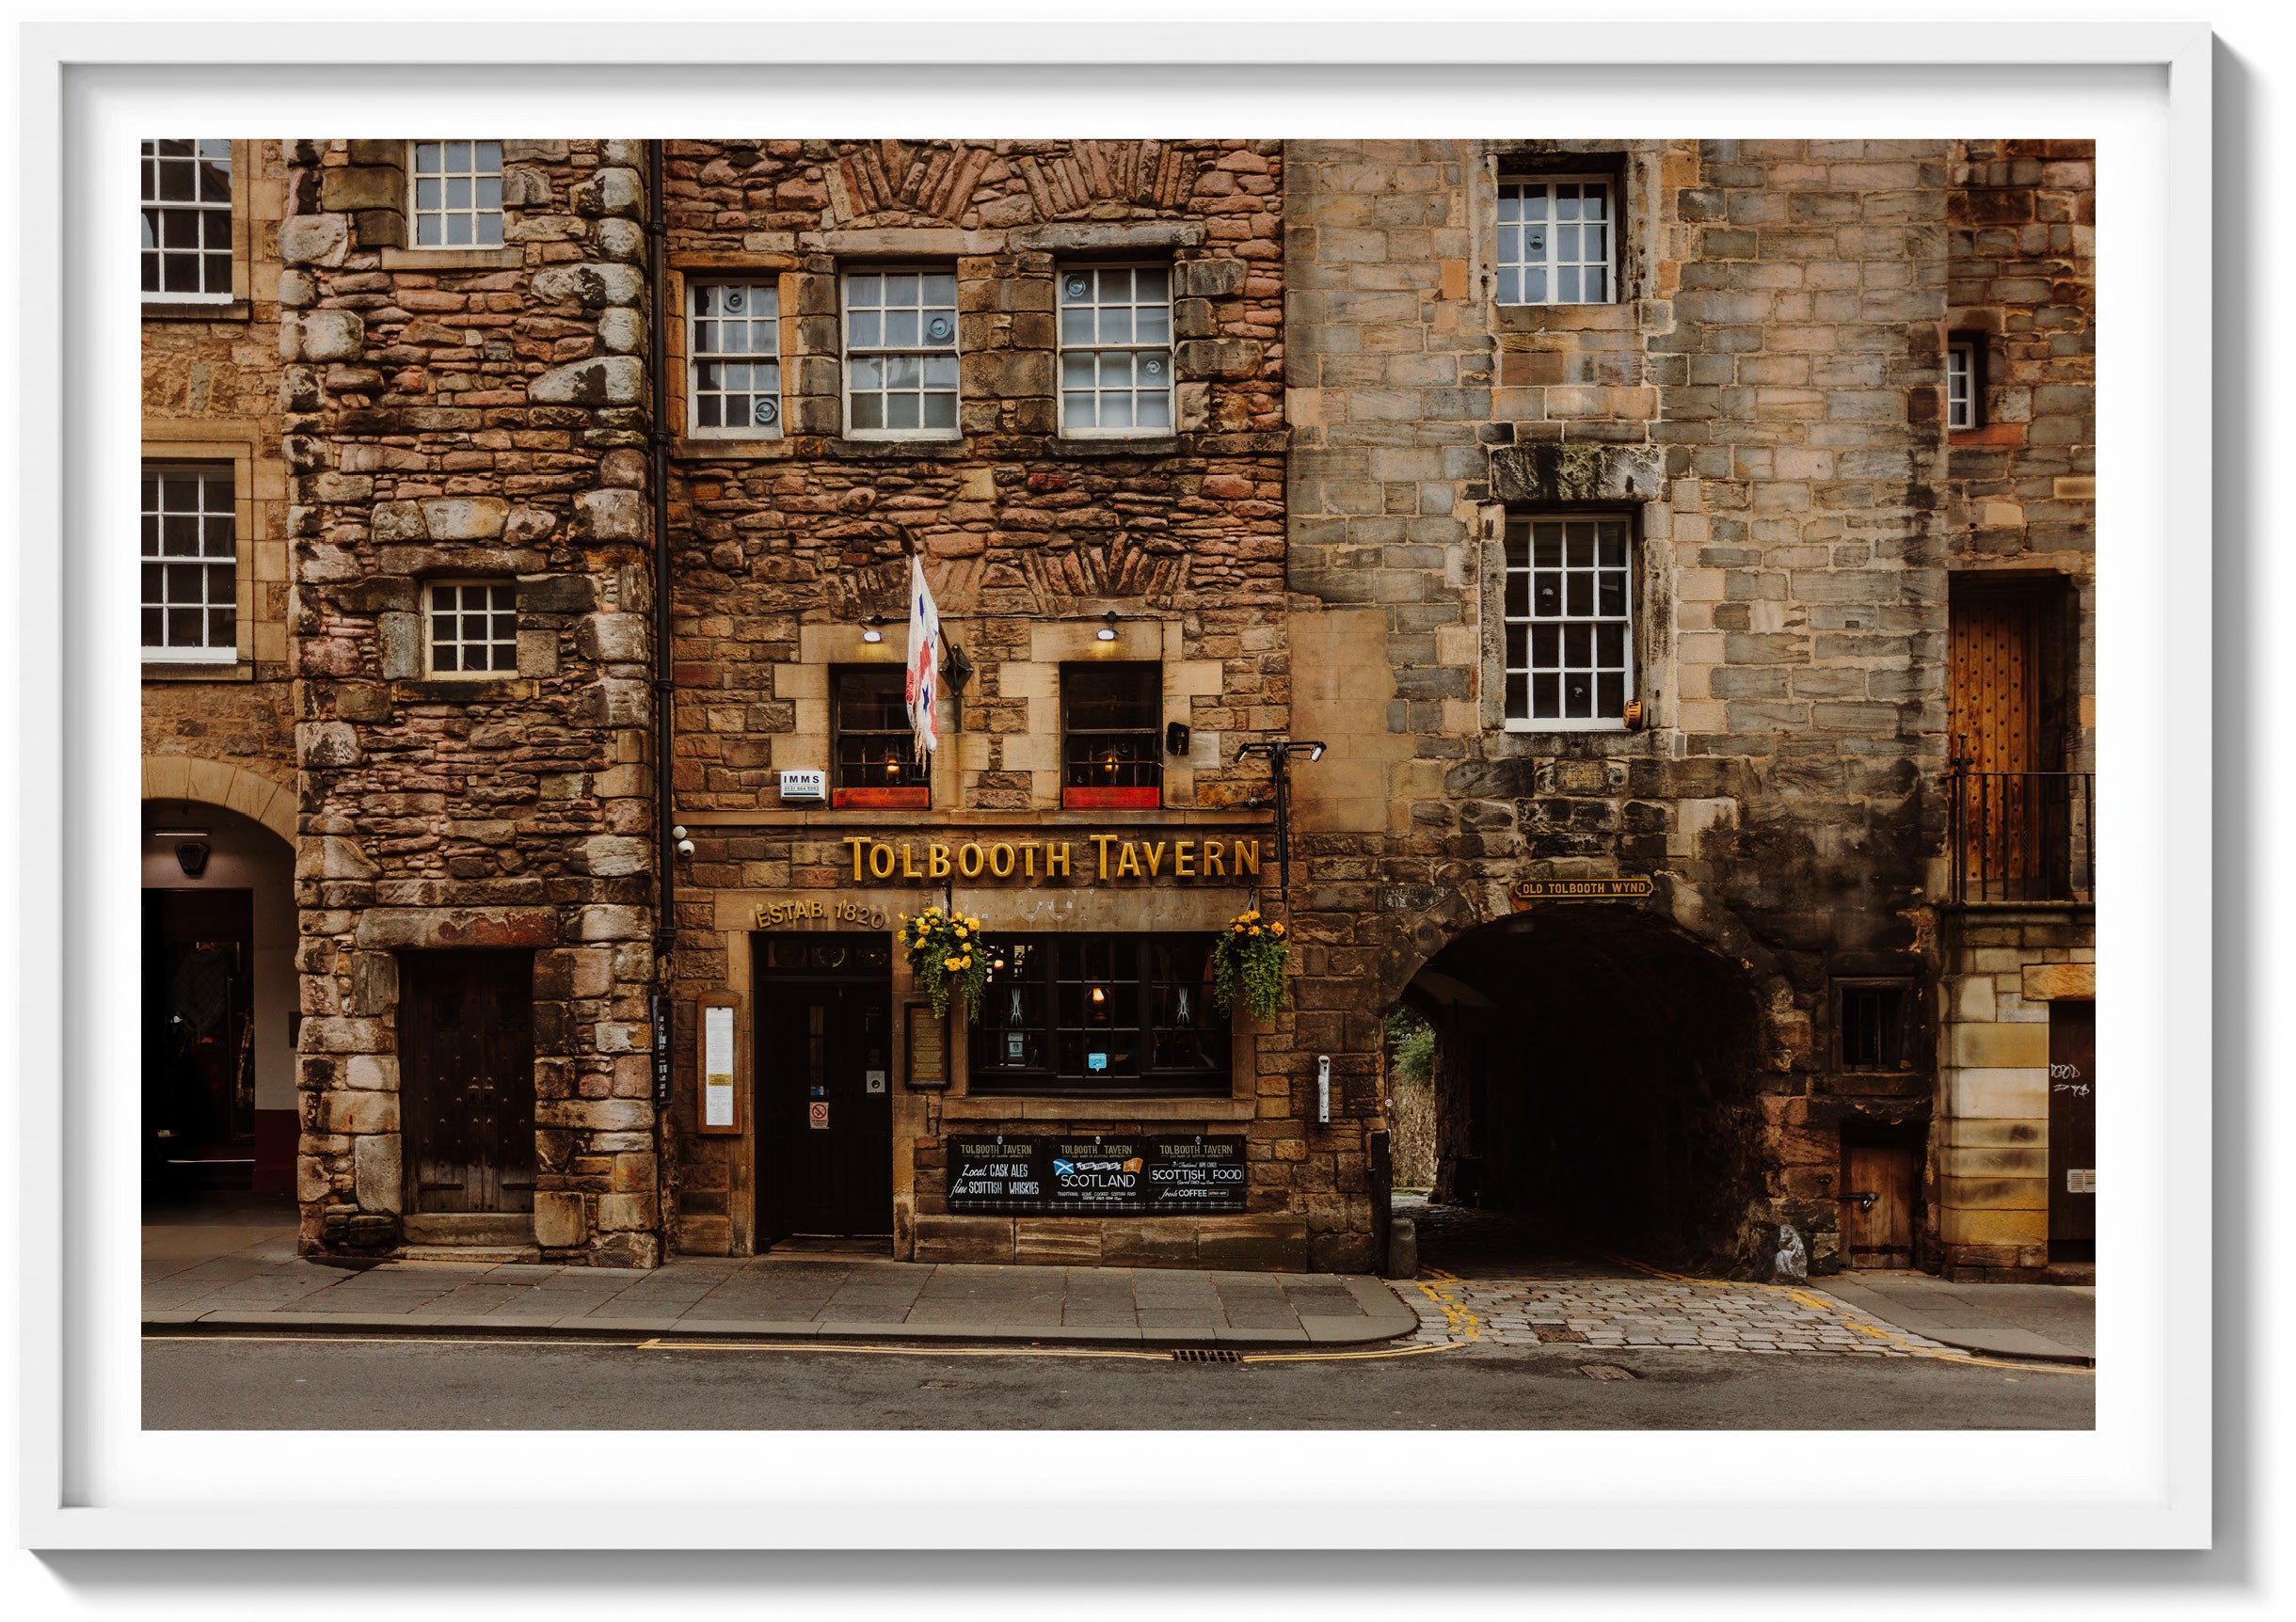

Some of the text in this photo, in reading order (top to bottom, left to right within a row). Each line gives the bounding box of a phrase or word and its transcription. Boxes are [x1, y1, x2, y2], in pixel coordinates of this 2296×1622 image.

[843, 835, 1260, 882] TOLBOOTH TAVERN
[1523, 883, 1646, 894] OLD TOLBOOTH WYND
[756, 900, 885, 930] ESTAB. 1820
[960, 1144, 1032, 1155] TOLBOOTH TAVERN
[1060, 1144, 1133, 1155] TOLBOOTH TAVERN
[1159, 1144, 1234, 1155] TOLBOOTH TAVERN
[962, 1164, 1029, 1178] Local CASK ALES
[1152, 1169, 1242, 1181] SCOTTISH FOOD
[1060, 1174, 1136, 1187] SCOTLAND
[969, 1181, 1003, 1195] SCOTTISH
[1008, 1181, 1040, 1195] WHISKIES
